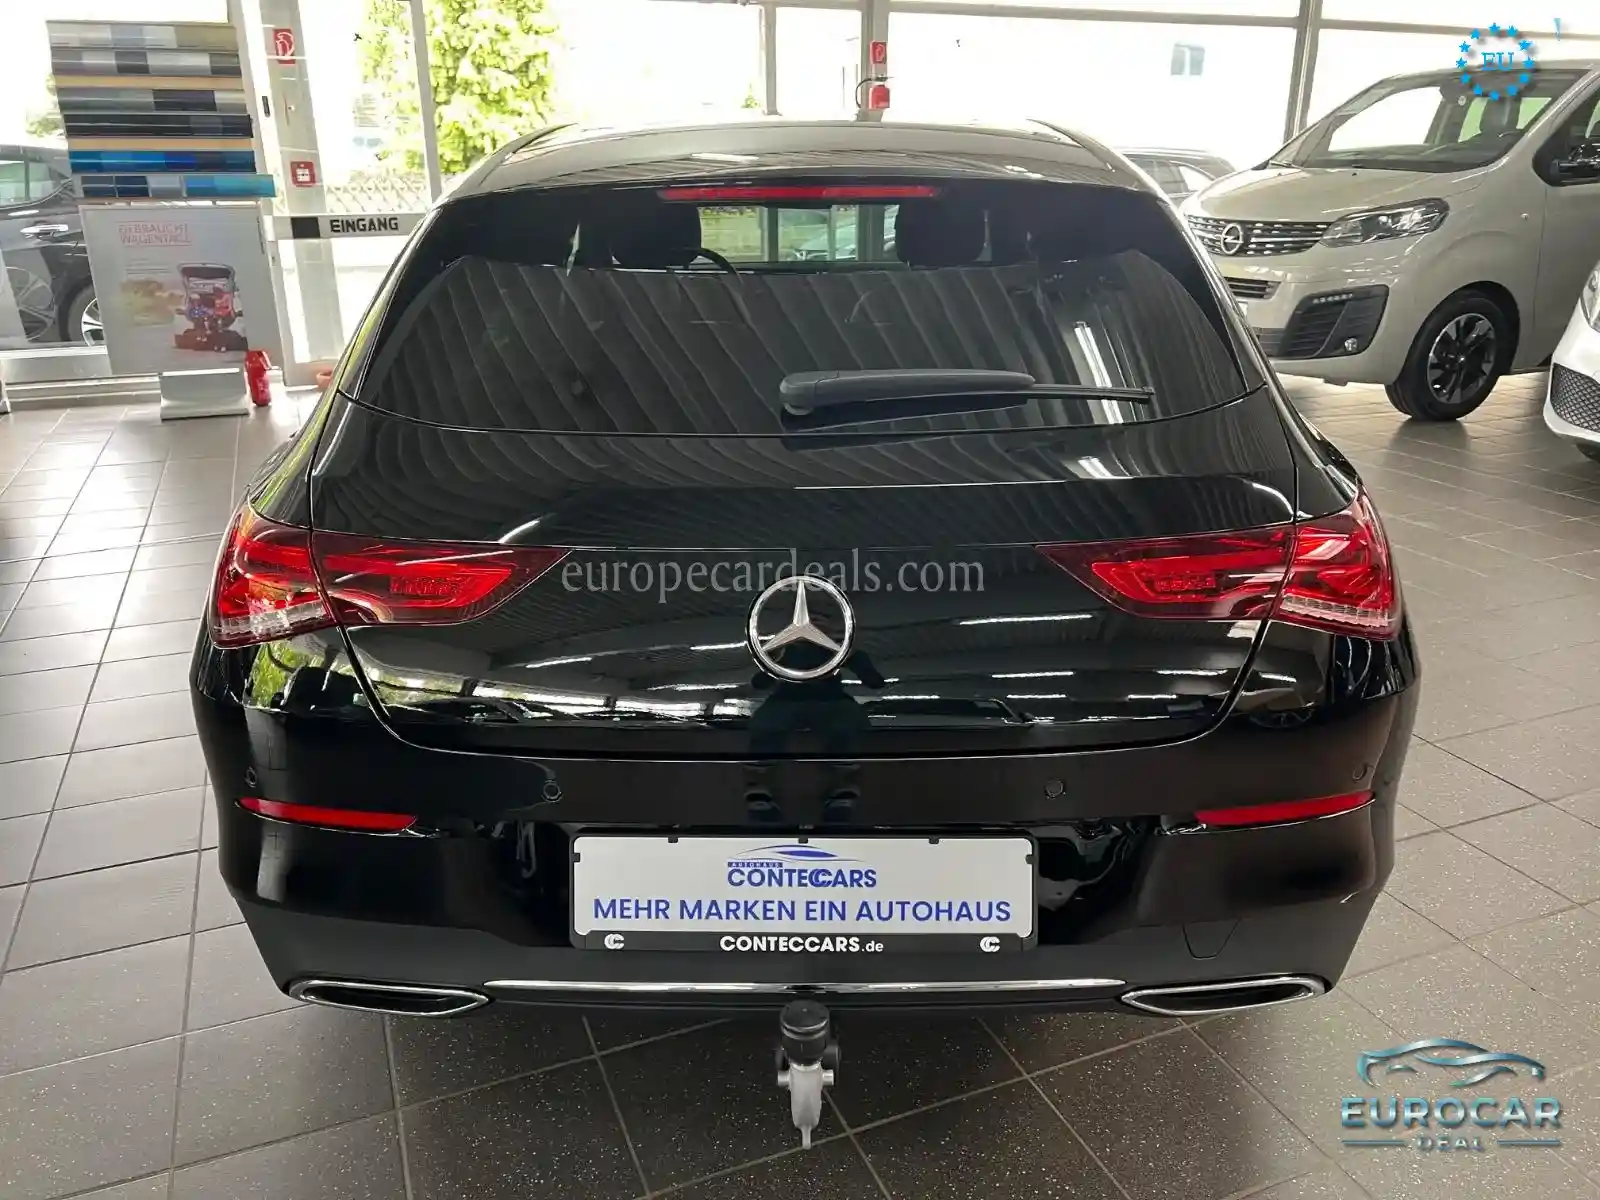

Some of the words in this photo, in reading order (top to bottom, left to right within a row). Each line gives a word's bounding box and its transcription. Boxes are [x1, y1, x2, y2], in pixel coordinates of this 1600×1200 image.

[330, 217, 399, 233] EINGANG
[593, 898, 670, 920] MEHR
[680, 899, 796, 921] MARKEN
[805, 900, 847, 921] EIN
[855, 900, 1011, 922] AUTOHAUS
[719, 936, 884, 953] CONTECCARS.de
